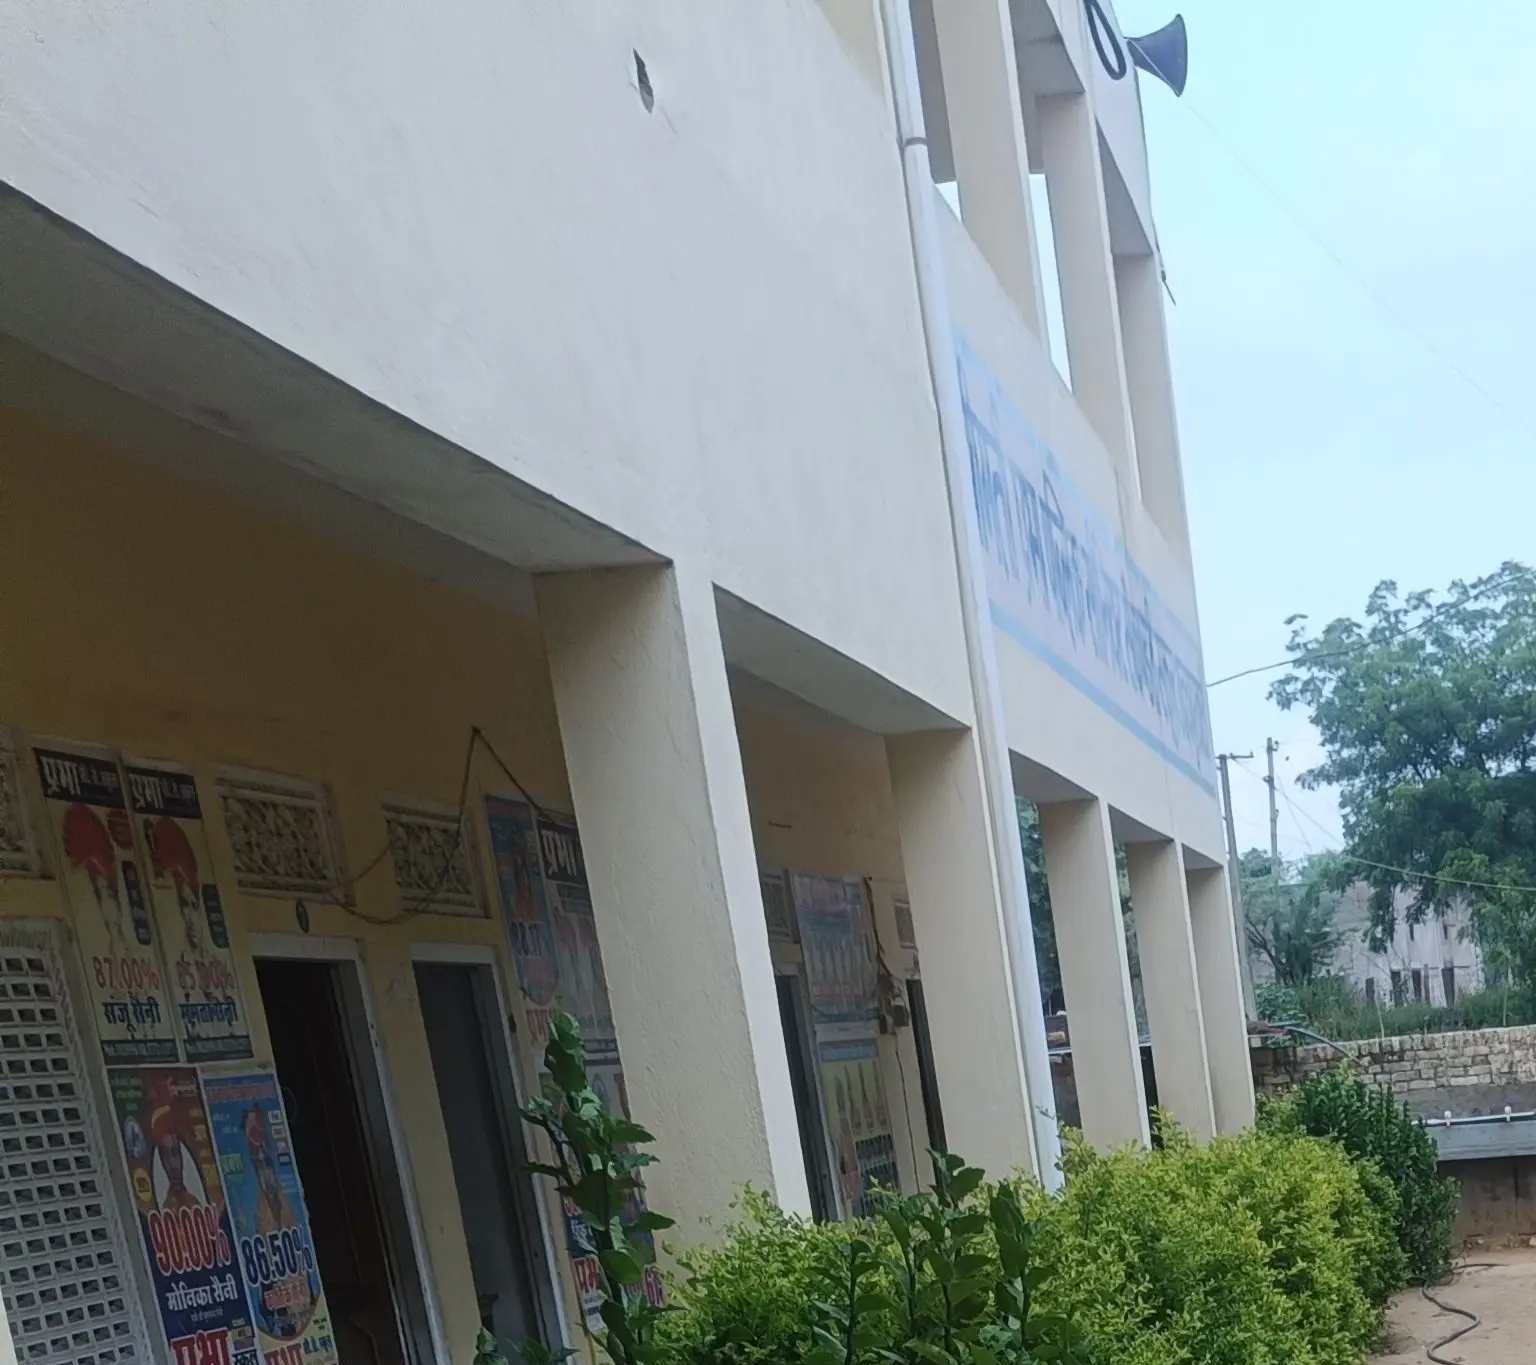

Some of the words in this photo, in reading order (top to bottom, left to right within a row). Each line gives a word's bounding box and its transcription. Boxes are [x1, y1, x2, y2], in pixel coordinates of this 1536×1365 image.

[92, 956, 159, 989] 87.00%
[148, 1203, 232, 1276] 90.00%
[240, 1225, 314, 1287] 86.50%
[165, 1280, 213, 1311] मोनिका
